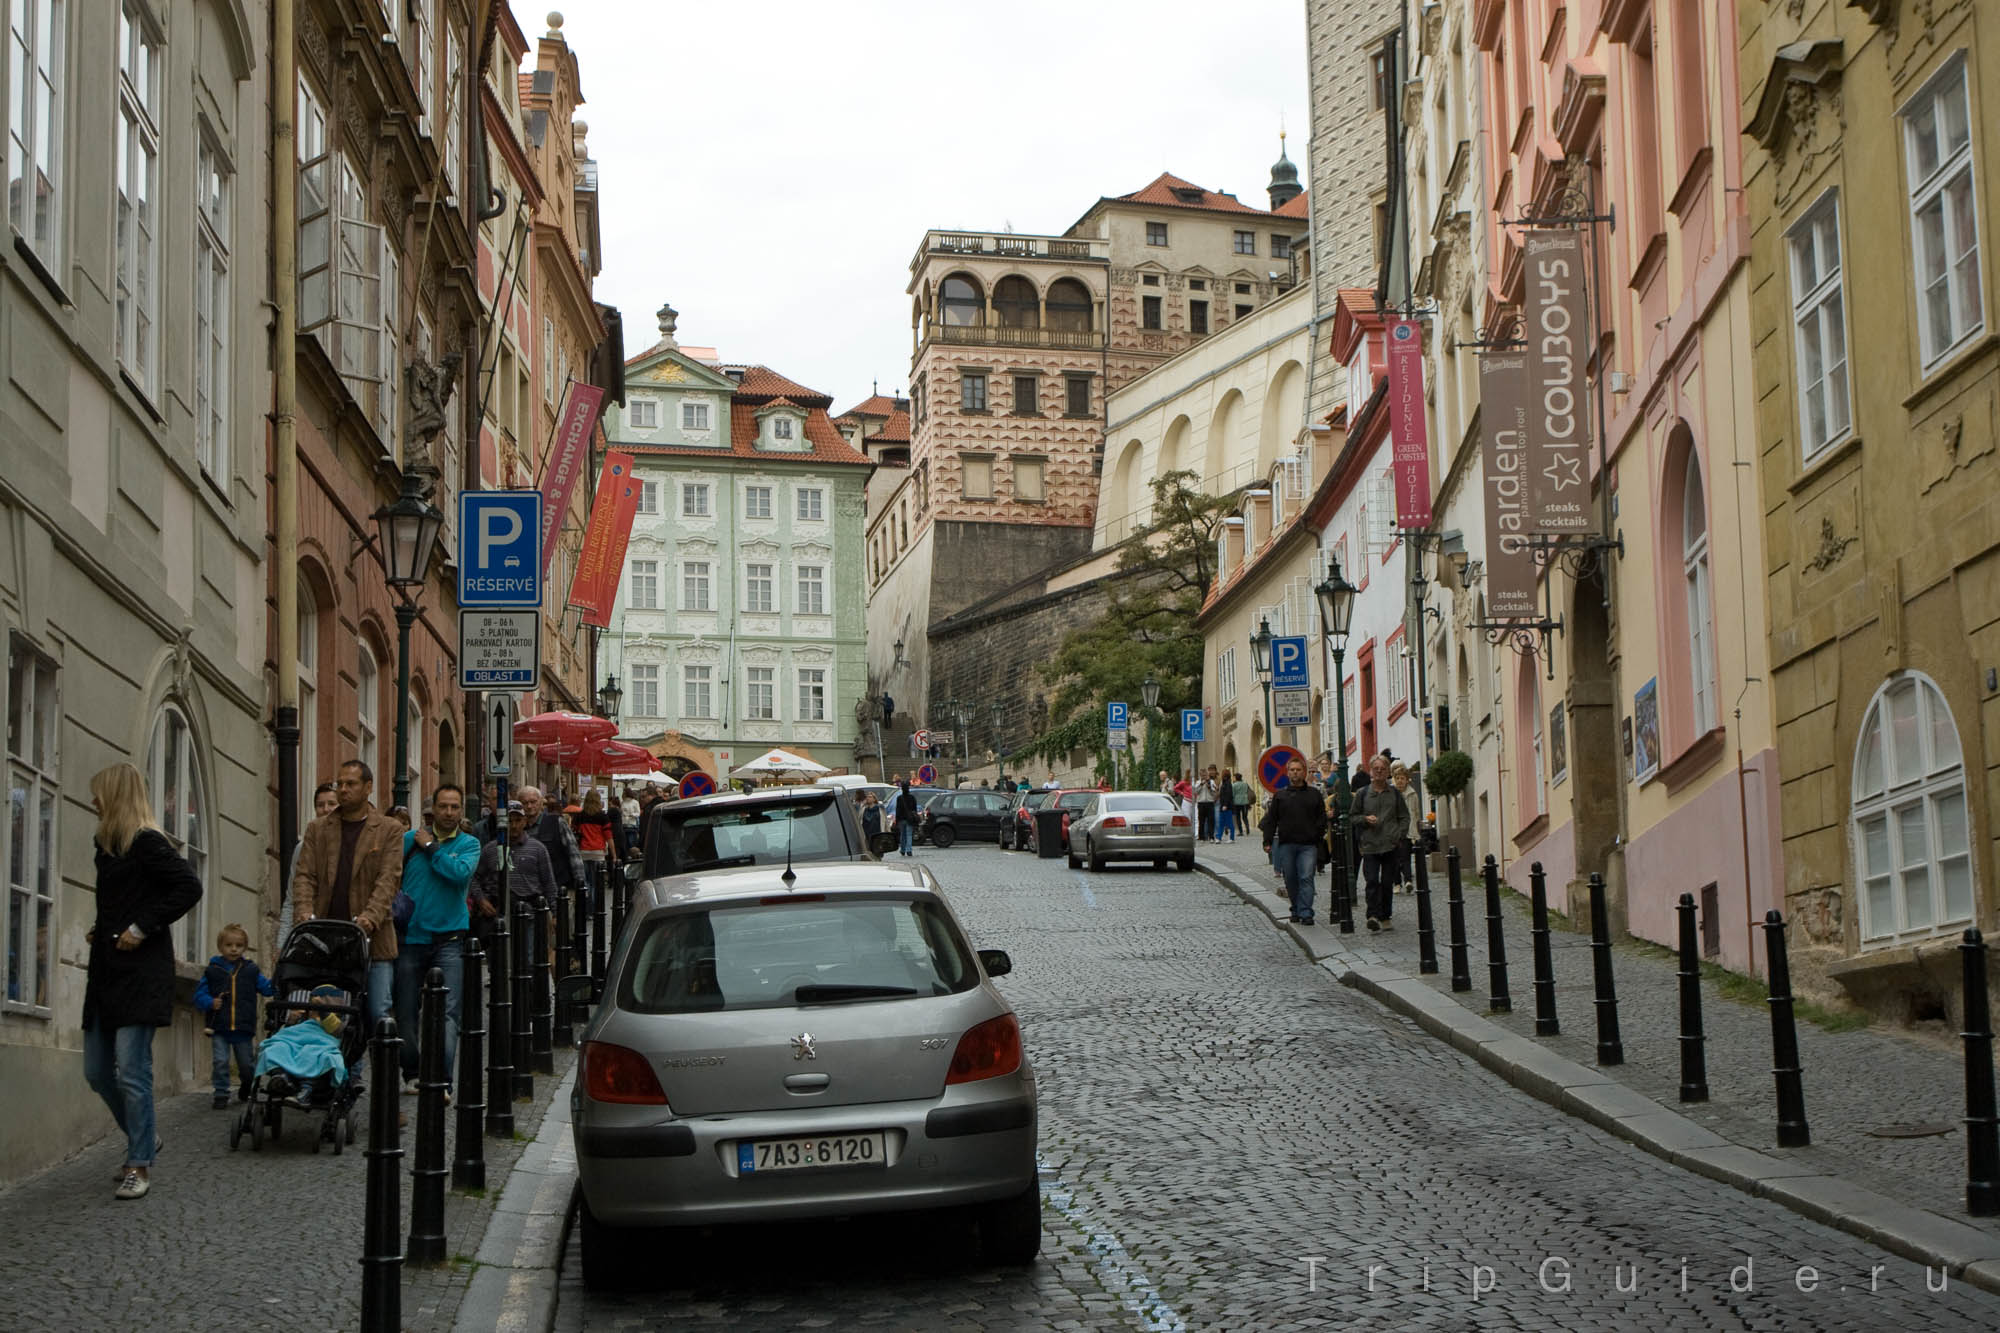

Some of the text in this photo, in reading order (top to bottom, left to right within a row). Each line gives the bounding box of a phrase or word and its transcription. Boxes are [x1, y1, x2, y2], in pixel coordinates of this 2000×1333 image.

[1538, 259, 1575, 438] COWBOYS
[1401, 355, 1414, 441] RESIDENCE
[555, 402, 590, 486] EXCHANGE
[1397, 444, 1422, 453] GREEN
[1395, 452, 1426, 461] LOBSTER
[1515, 407, 1530, 517] panoramatic top roof
[550, 488, 562, 499] &
[1407, 465, 1417, 512] HOTEL
[1488, 430, 1530, 555] garden
[1545, 502, 1581, 512] steaks
[1539, 516, 1588, 527] cocktails
[478, 507, 523, 569] P
[582, 550, 597, 583] HOTEL
[590, 492, 612, 546] RESIDENCE
[466, 576, 534, 591] RÉSERVÉ
[1497, 590, 1528, 599] steaks
[1492, 602, 1534, 611] cocktails
[509, 618, 514, 627] h
[480, 628, 518, 637] S PLATNOU
[506, 639, 533, 647] KARTOU
[509, 649, 513, 657] h
[1278, 643, 1299, 672] P
[477, 660, 489, 668] BEZ
[474, 672, 524, 681] OBLAST 1
[1112, 705, 1124, 721] P
[1186, 713, 1200, 732] P
[920, 1038, 950, 1050] 307
[758, 1137, 873, 1167] 7A3 6120
